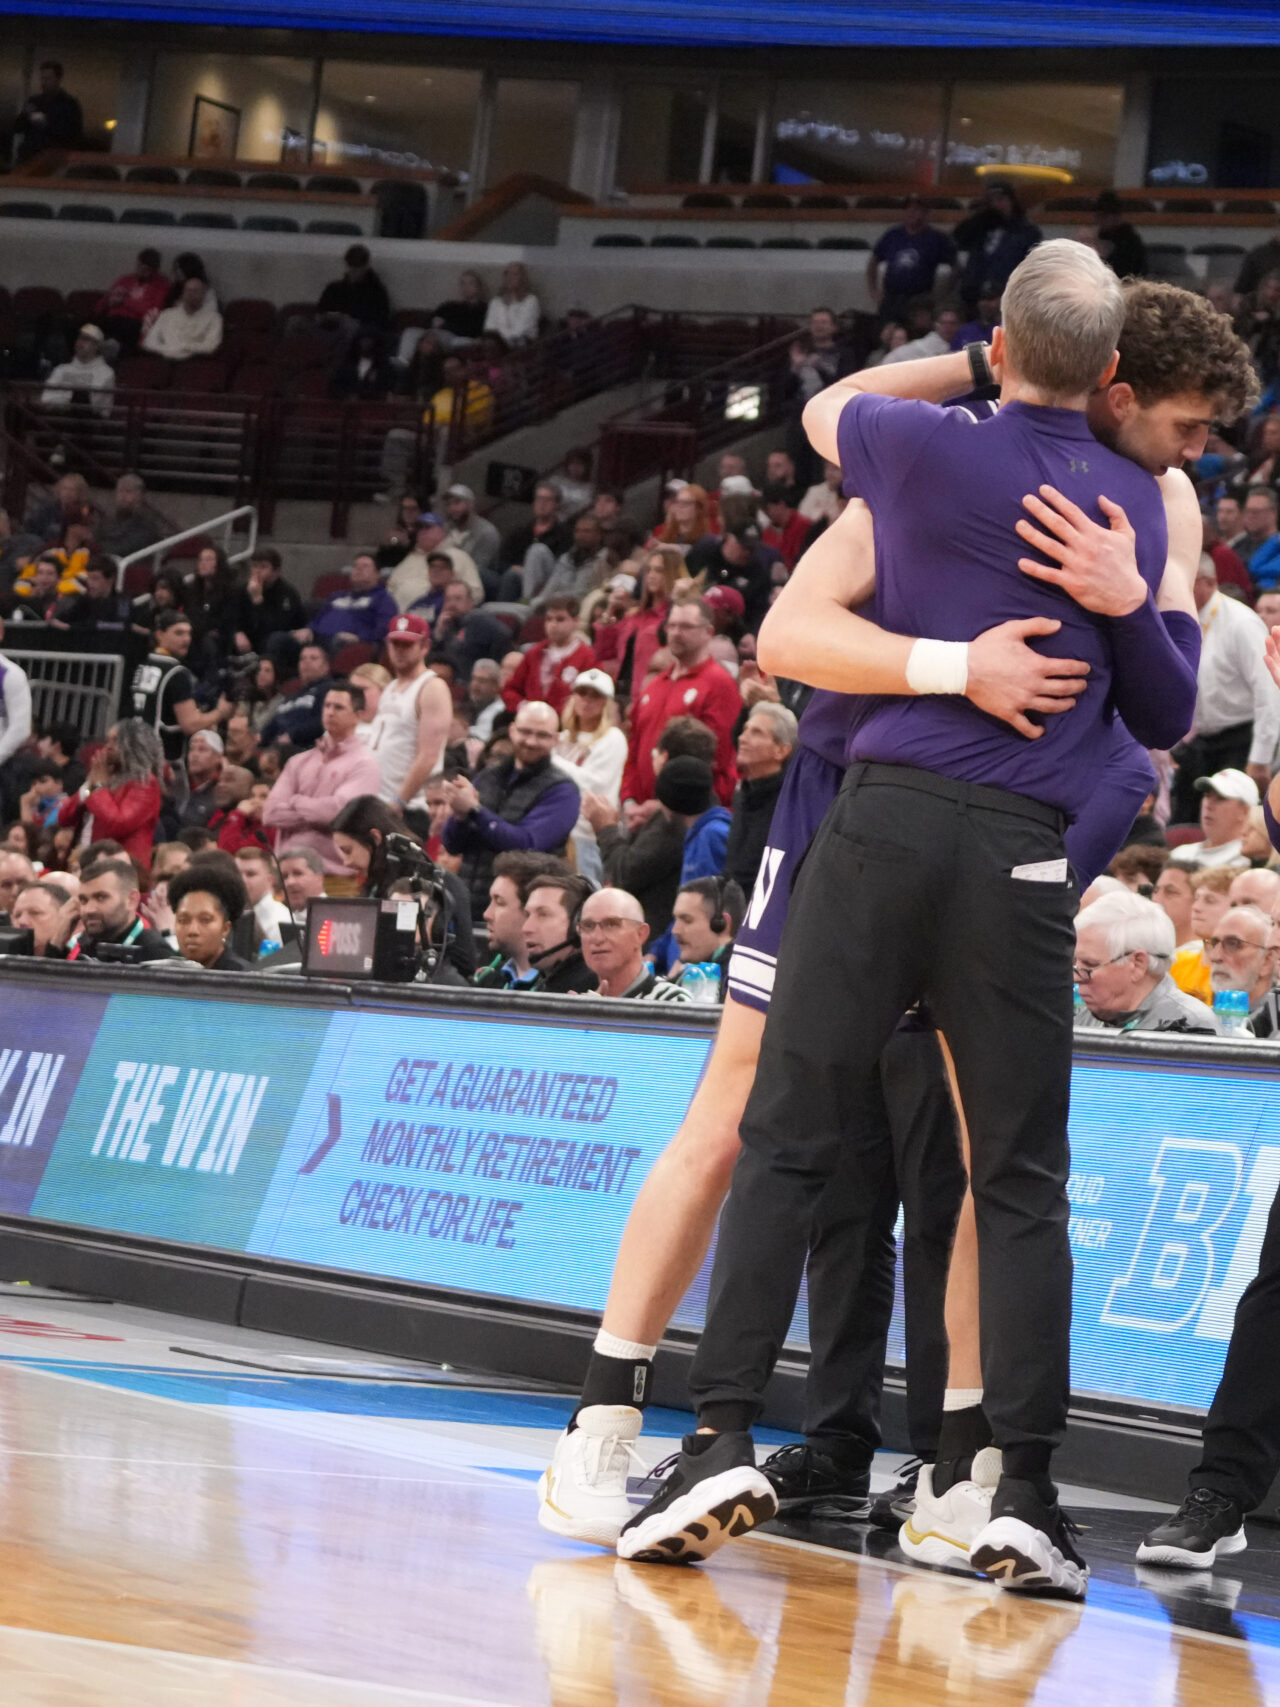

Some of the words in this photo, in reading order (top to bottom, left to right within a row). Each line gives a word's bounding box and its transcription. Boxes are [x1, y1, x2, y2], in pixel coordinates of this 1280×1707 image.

[91, 1061, 181, 1163] THE
[161, 1068, 270, 1175] WIN
[385, 1058, 439, 1104] GET
[428, 1062, 454, 1107] A
[450, 1063, 618, 1124] GUARANTEED
[360, 1118, 481, 1175] MONTHLY
[473, 1129, 642, 1195] RETIREMENT
[1066, 1174, 1105, 1204] OUD
[339, 1179, 425, 1234] CHECK
[413, 1189, 470, 1241] FOR
[462, 1196, 524, 1251] LIFE
